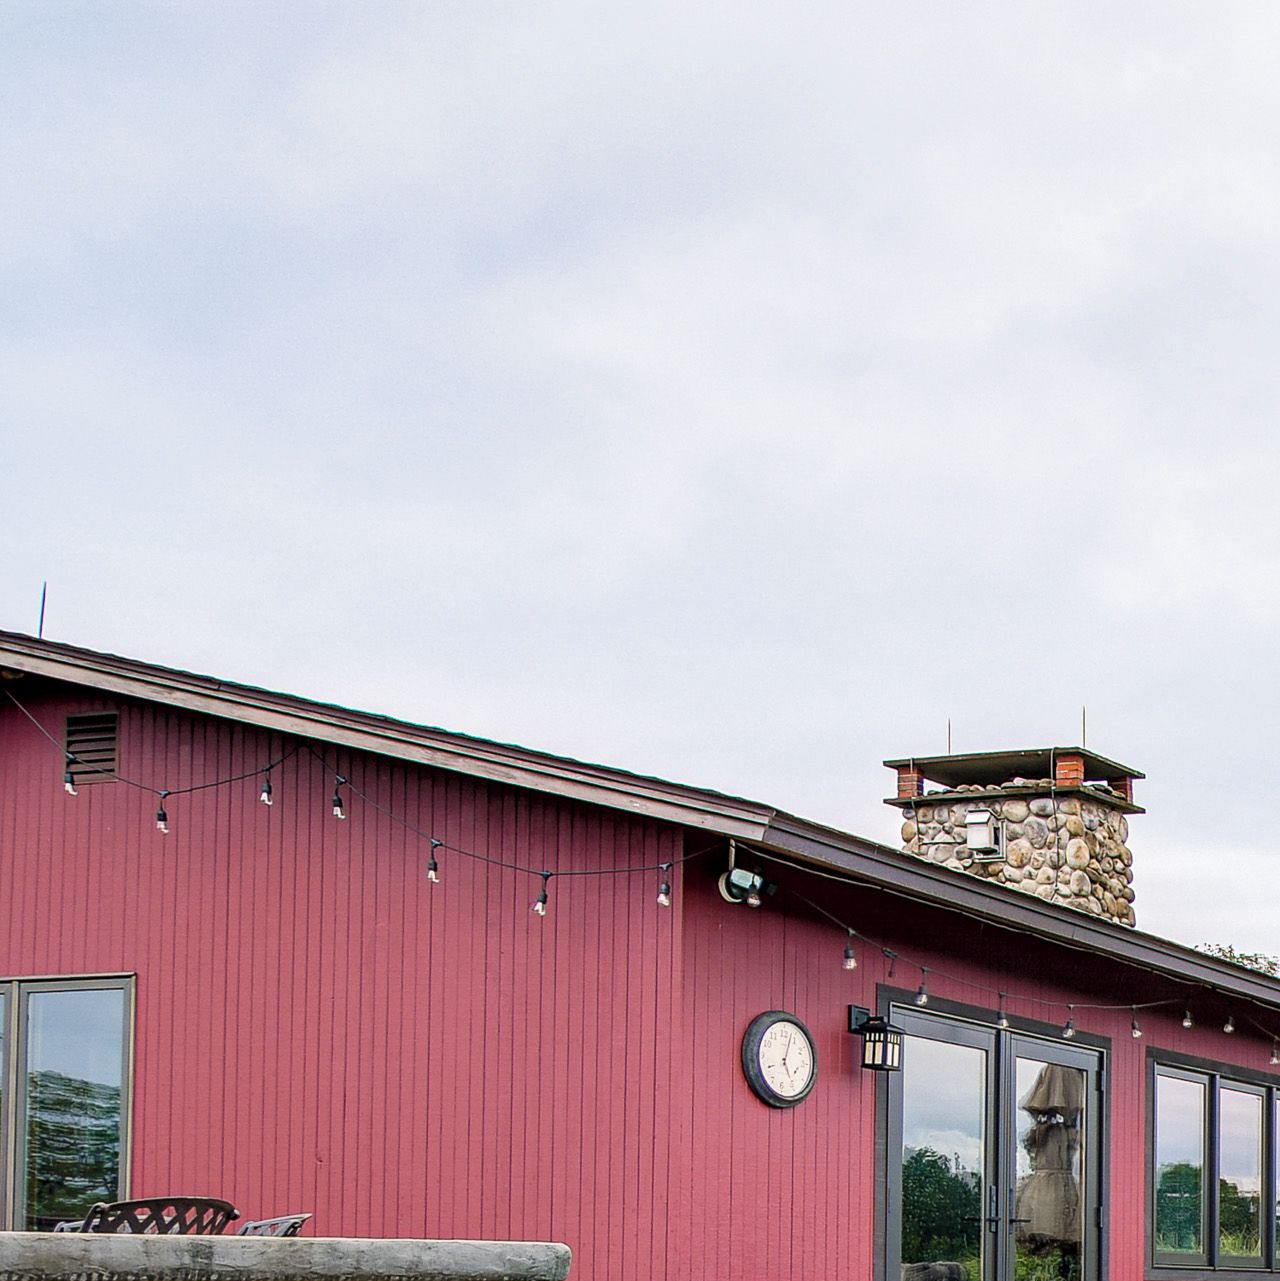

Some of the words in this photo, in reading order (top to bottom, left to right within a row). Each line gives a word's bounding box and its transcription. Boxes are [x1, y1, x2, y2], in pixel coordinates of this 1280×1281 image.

[770, 1031, 777, 1040] 11
[781, 1029, 789, 1038] 12
[764, 1039, 772, 1048] 10
